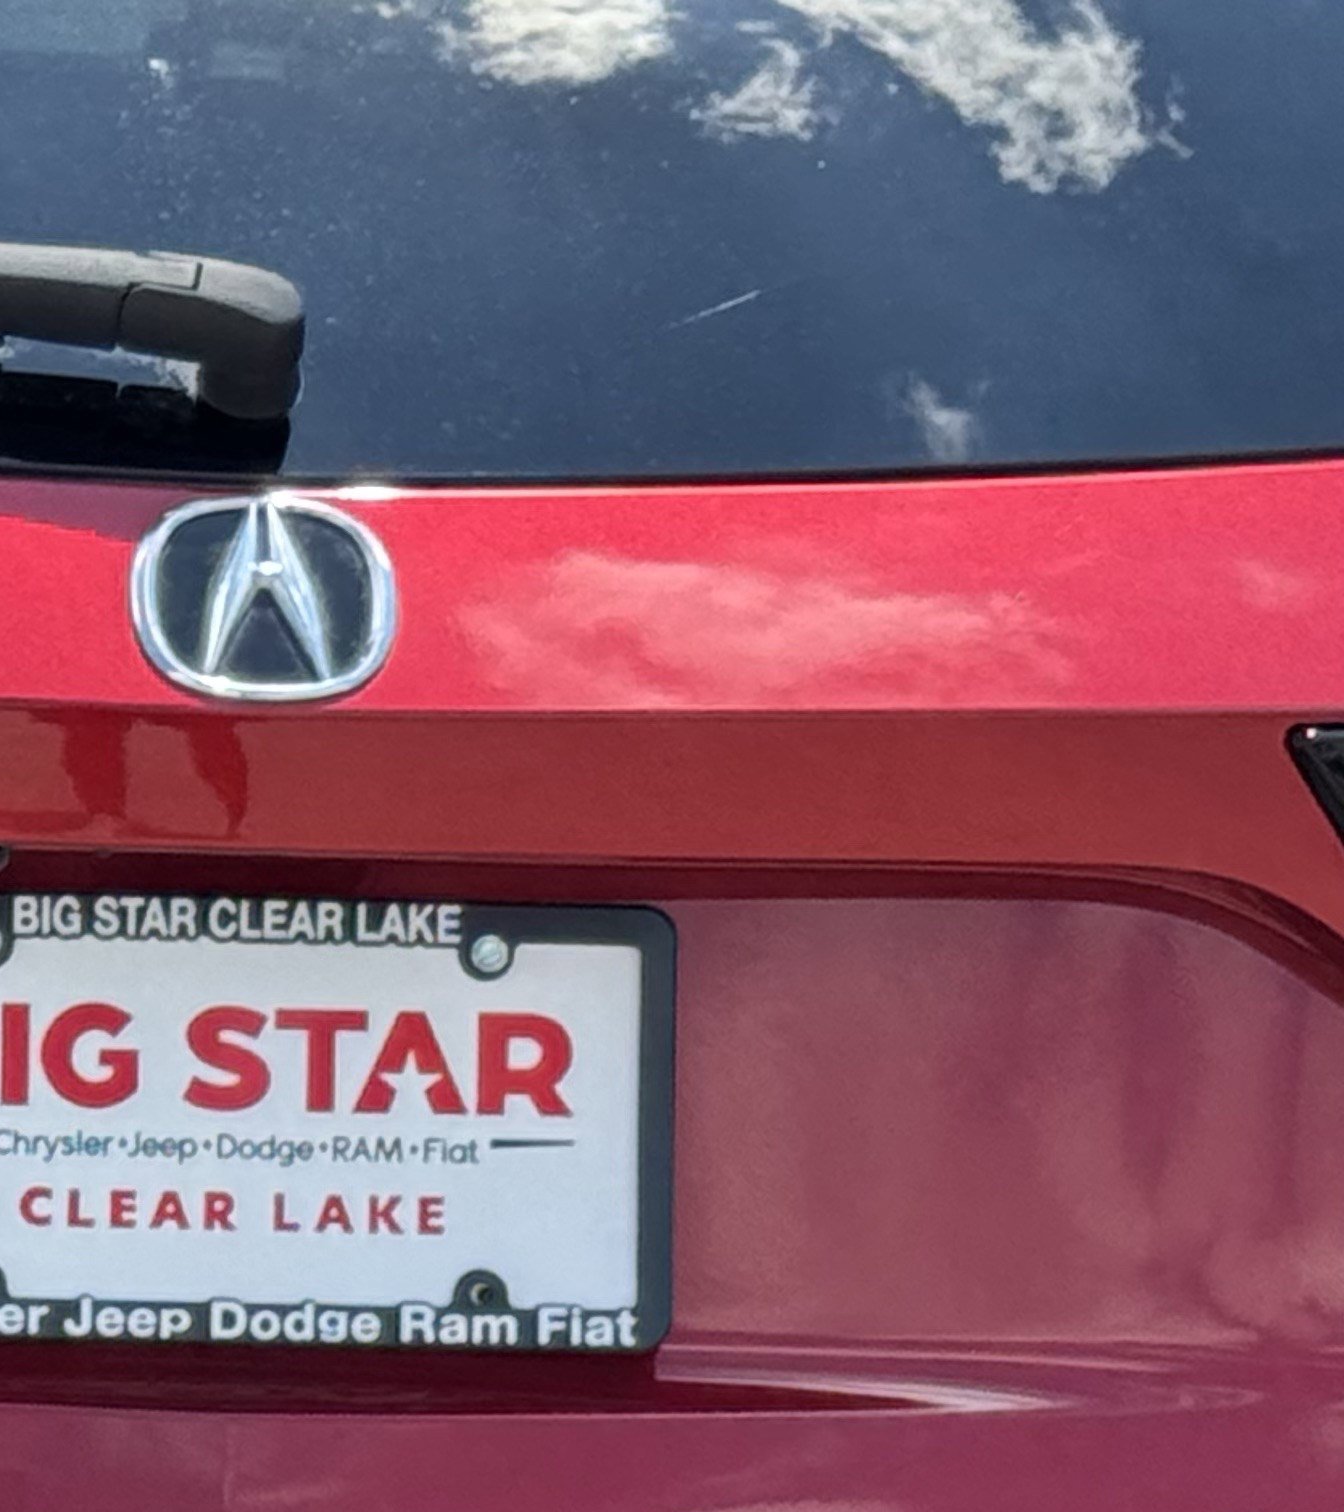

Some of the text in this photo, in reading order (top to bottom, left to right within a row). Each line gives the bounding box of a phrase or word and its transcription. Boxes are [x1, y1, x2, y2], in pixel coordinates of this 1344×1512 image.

[13, 896, 462, 943] BIG STAR CLEAR LAKE
[183, 1005, 574, 1117] STAR
[19, 1186, 446, 1236] CLEAR LAKE
[63, 1294, 192, 1339] Jeep
[211, 1299, 381, 1343] Dodge
[399, 1304, 518, 1344] Ram
[537, 1306, 638, 1347] Fiat
